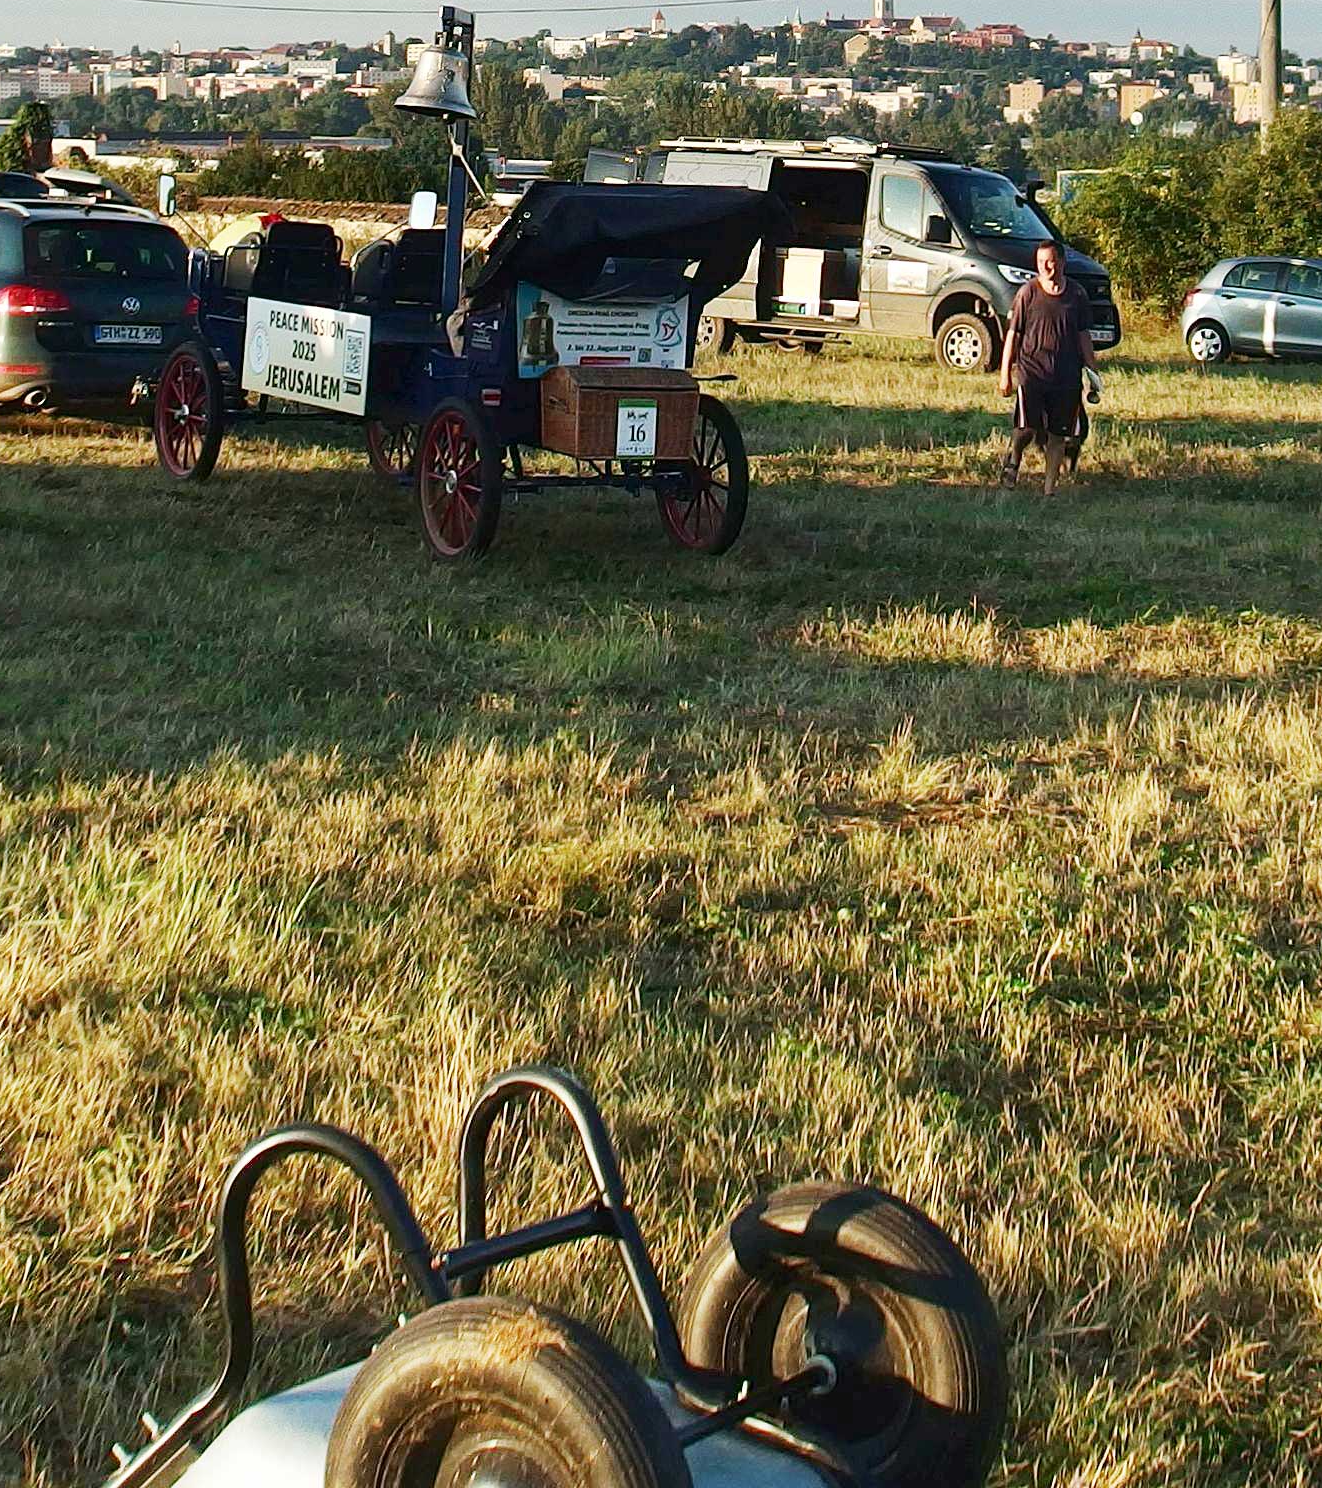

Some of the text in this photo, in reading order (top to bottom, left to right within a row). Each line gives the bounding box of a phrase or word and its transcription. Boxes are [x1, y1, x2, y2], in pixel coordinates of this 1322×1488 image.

[270, 310, 298, 331] PEACE
[292, 340, 316, 361] 2025
[597, 344, 619, 354] August
[266, 364, 340, 402] JERUSALEM
[629, 423, 646, 442] 16
